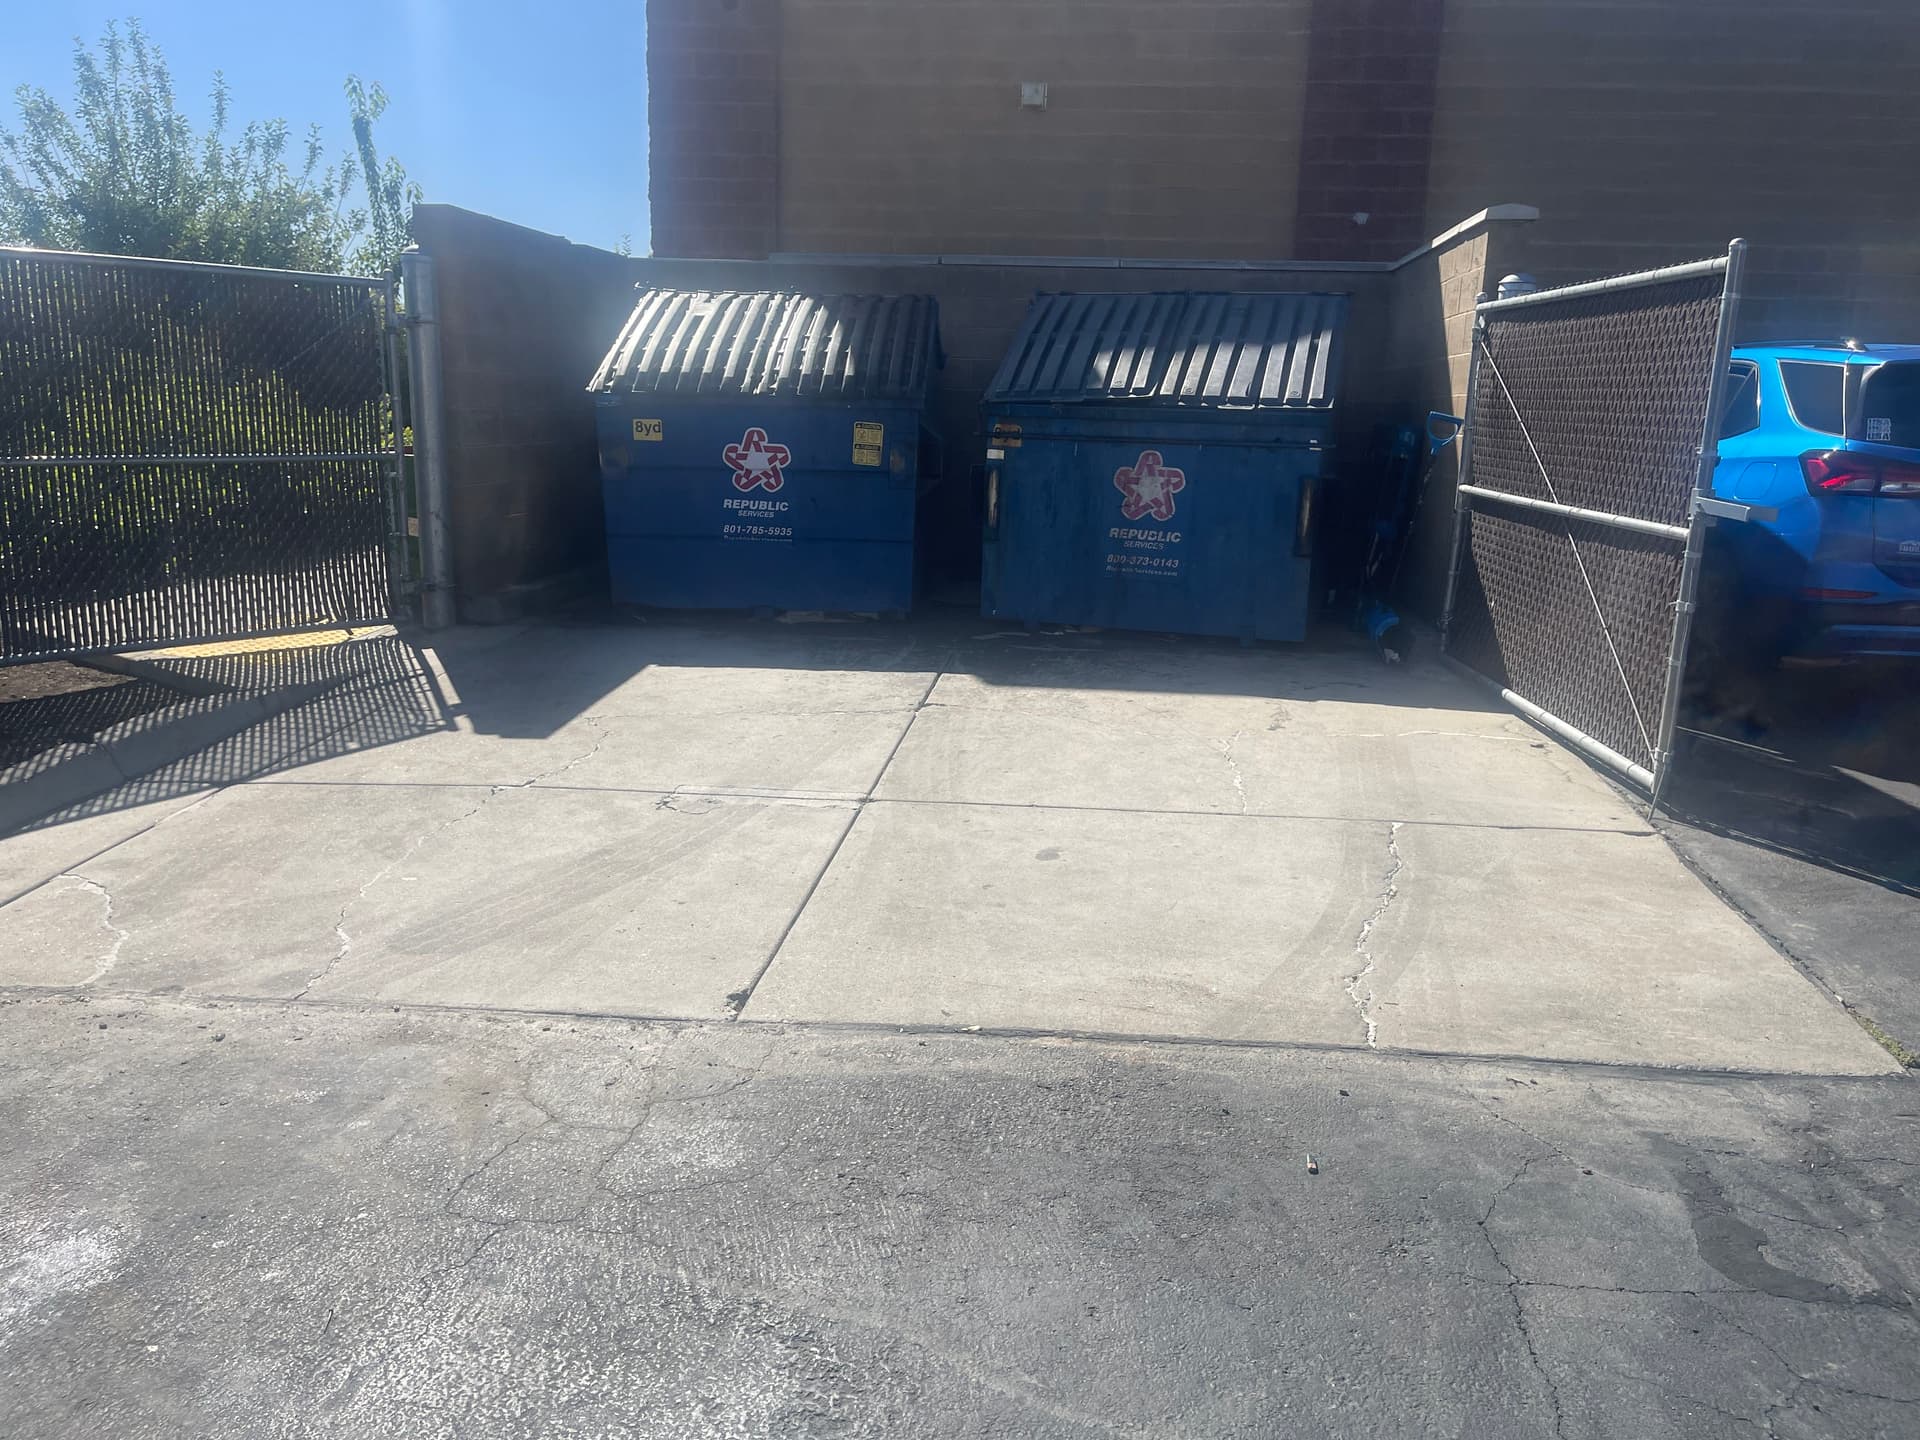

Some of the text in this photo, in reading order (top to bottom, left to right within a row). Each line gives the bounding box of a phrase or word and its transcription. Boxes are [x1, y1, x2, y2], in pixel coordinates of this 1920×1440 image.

[635, 420, 661, 436] 8yd
[723, 498, 789, 511] REPUBLIC
[738, 510, 774, 518] SERVICES
[723, 524, 792, 536] 801-785-5935
[1109, 527, 1182, 543] REPUBLIC
[1123, 540, 1164, 550] SERVICES
